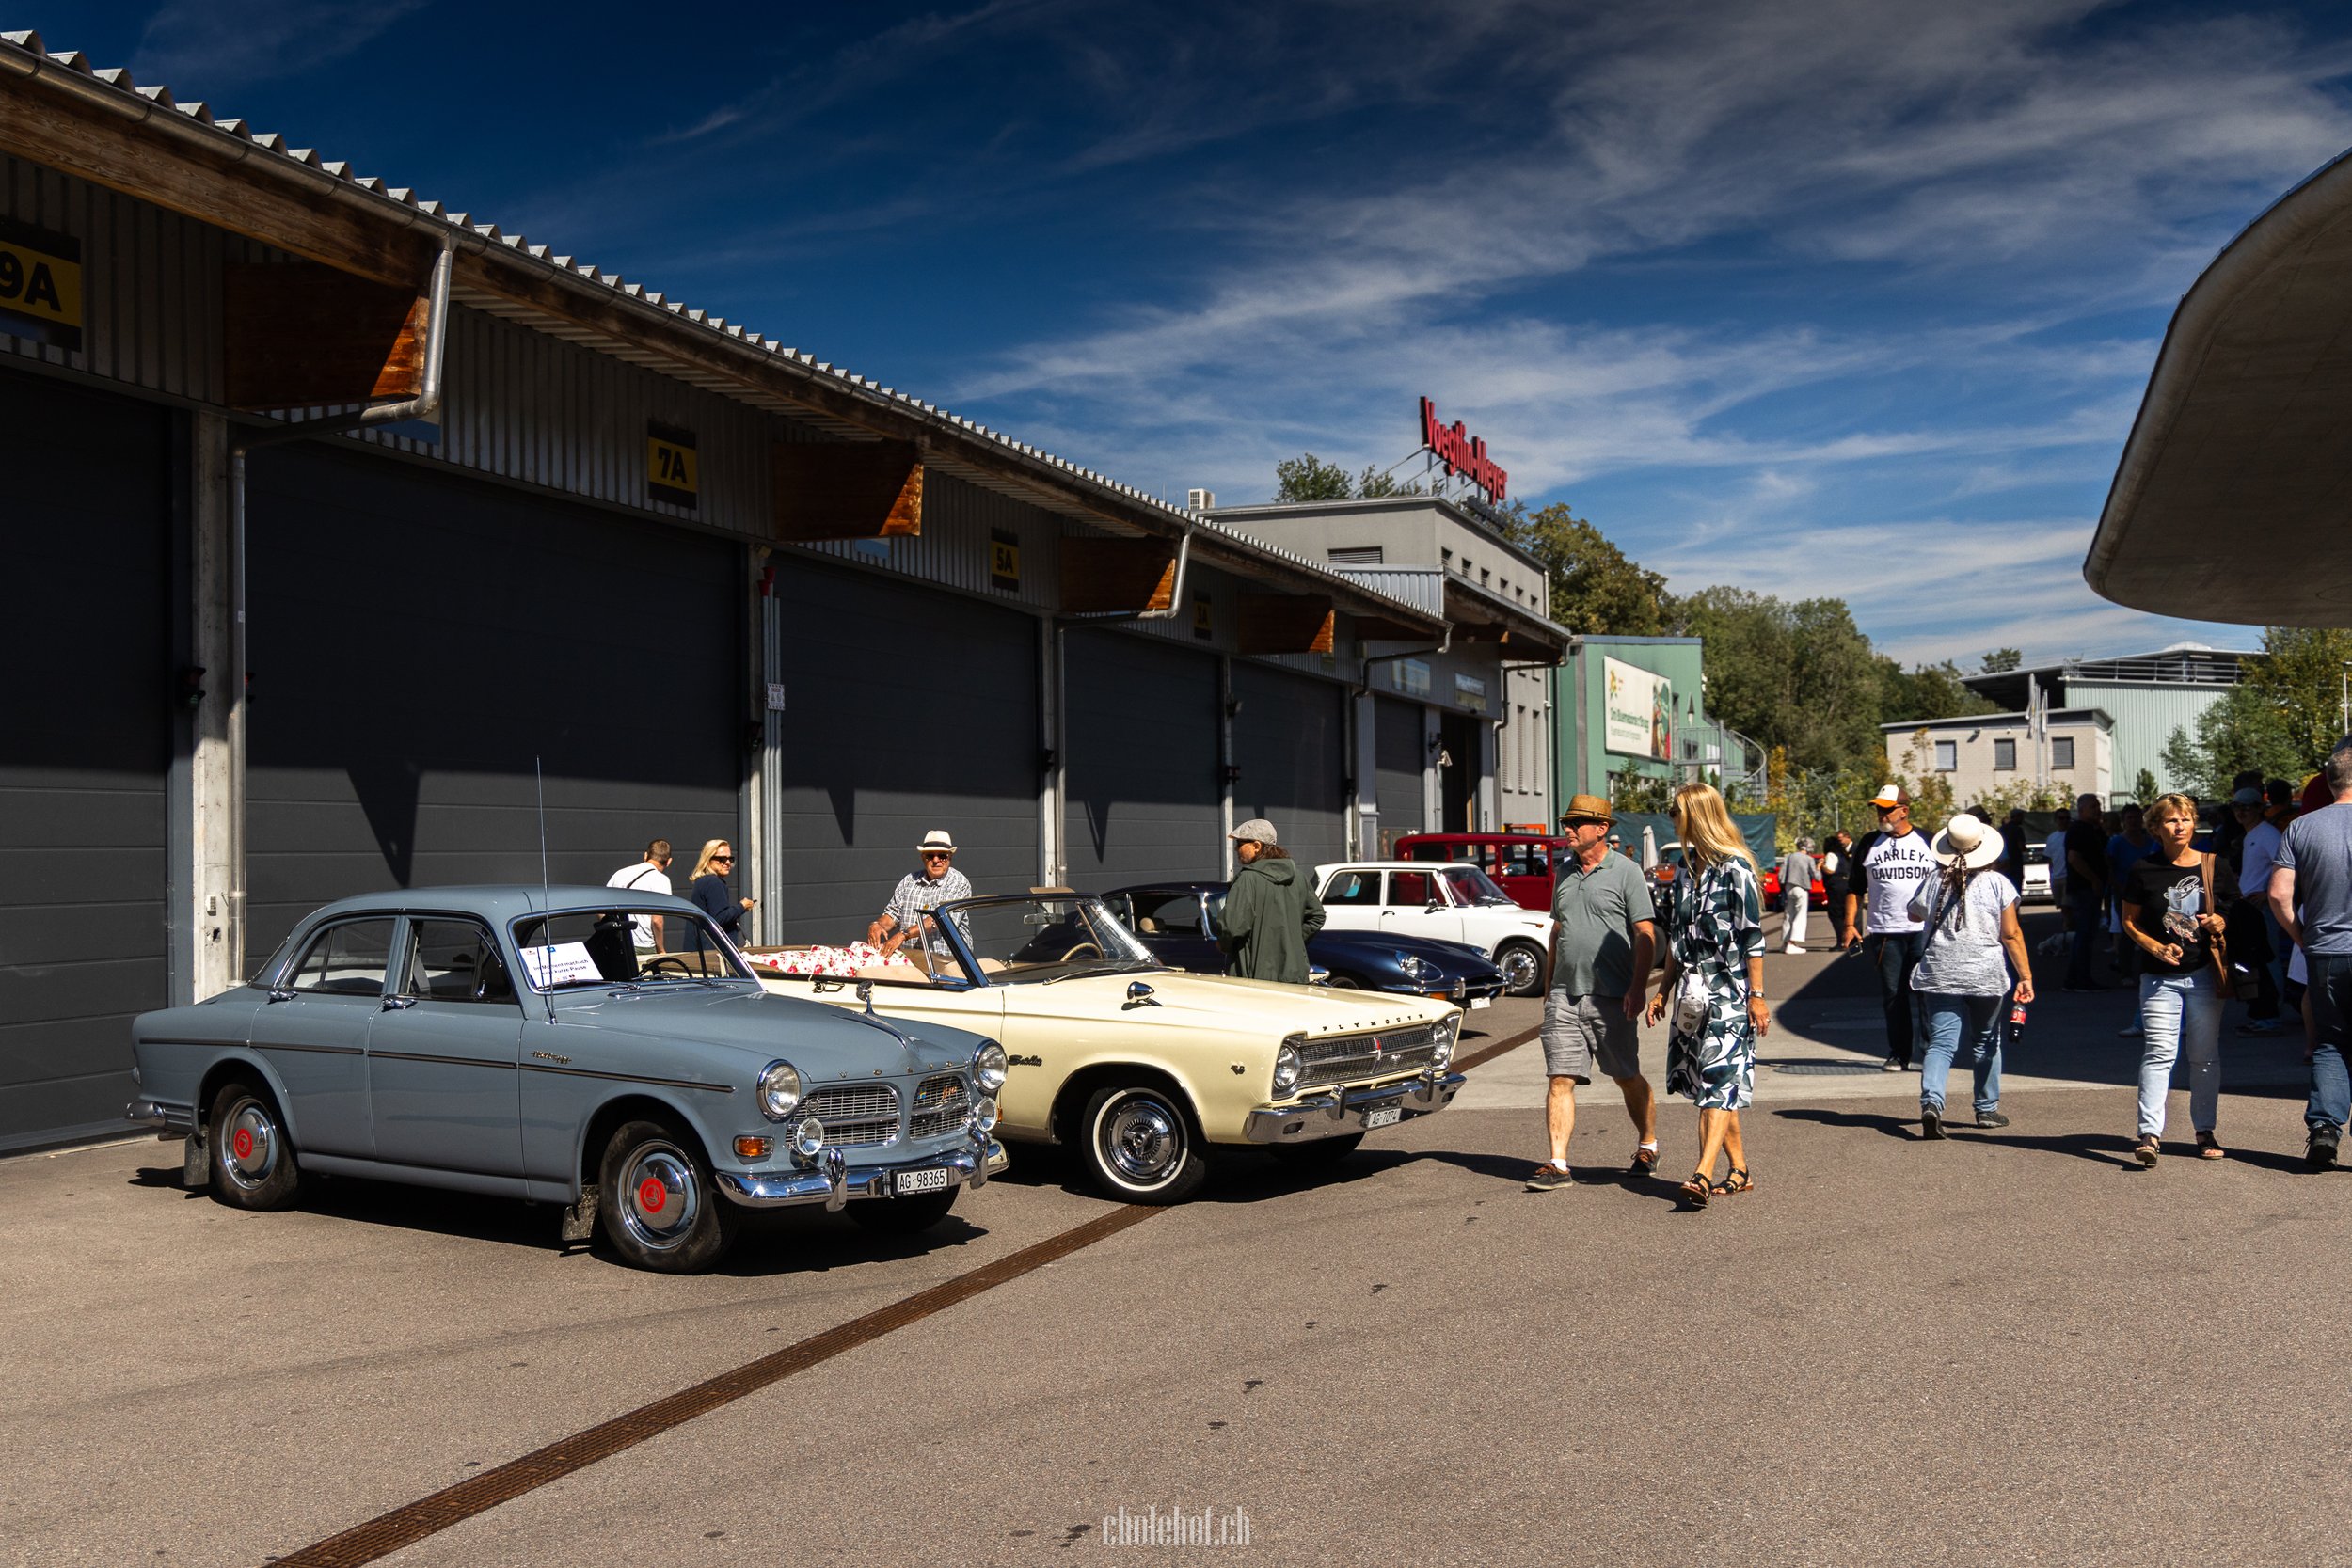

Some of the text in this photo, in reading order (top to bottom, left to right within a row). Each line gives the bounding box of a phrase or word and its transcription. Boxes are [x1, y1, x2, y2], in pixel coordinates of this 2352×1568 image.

[0, 251, 62, 312] 9A
[658, 446, 688, 484] 7A
[996, 546, 1014, 574] 5A
[1872, 866, 1930, 880] DAVIDSON
[1322, 1013, 1423, 1031] PLYMOUTH
